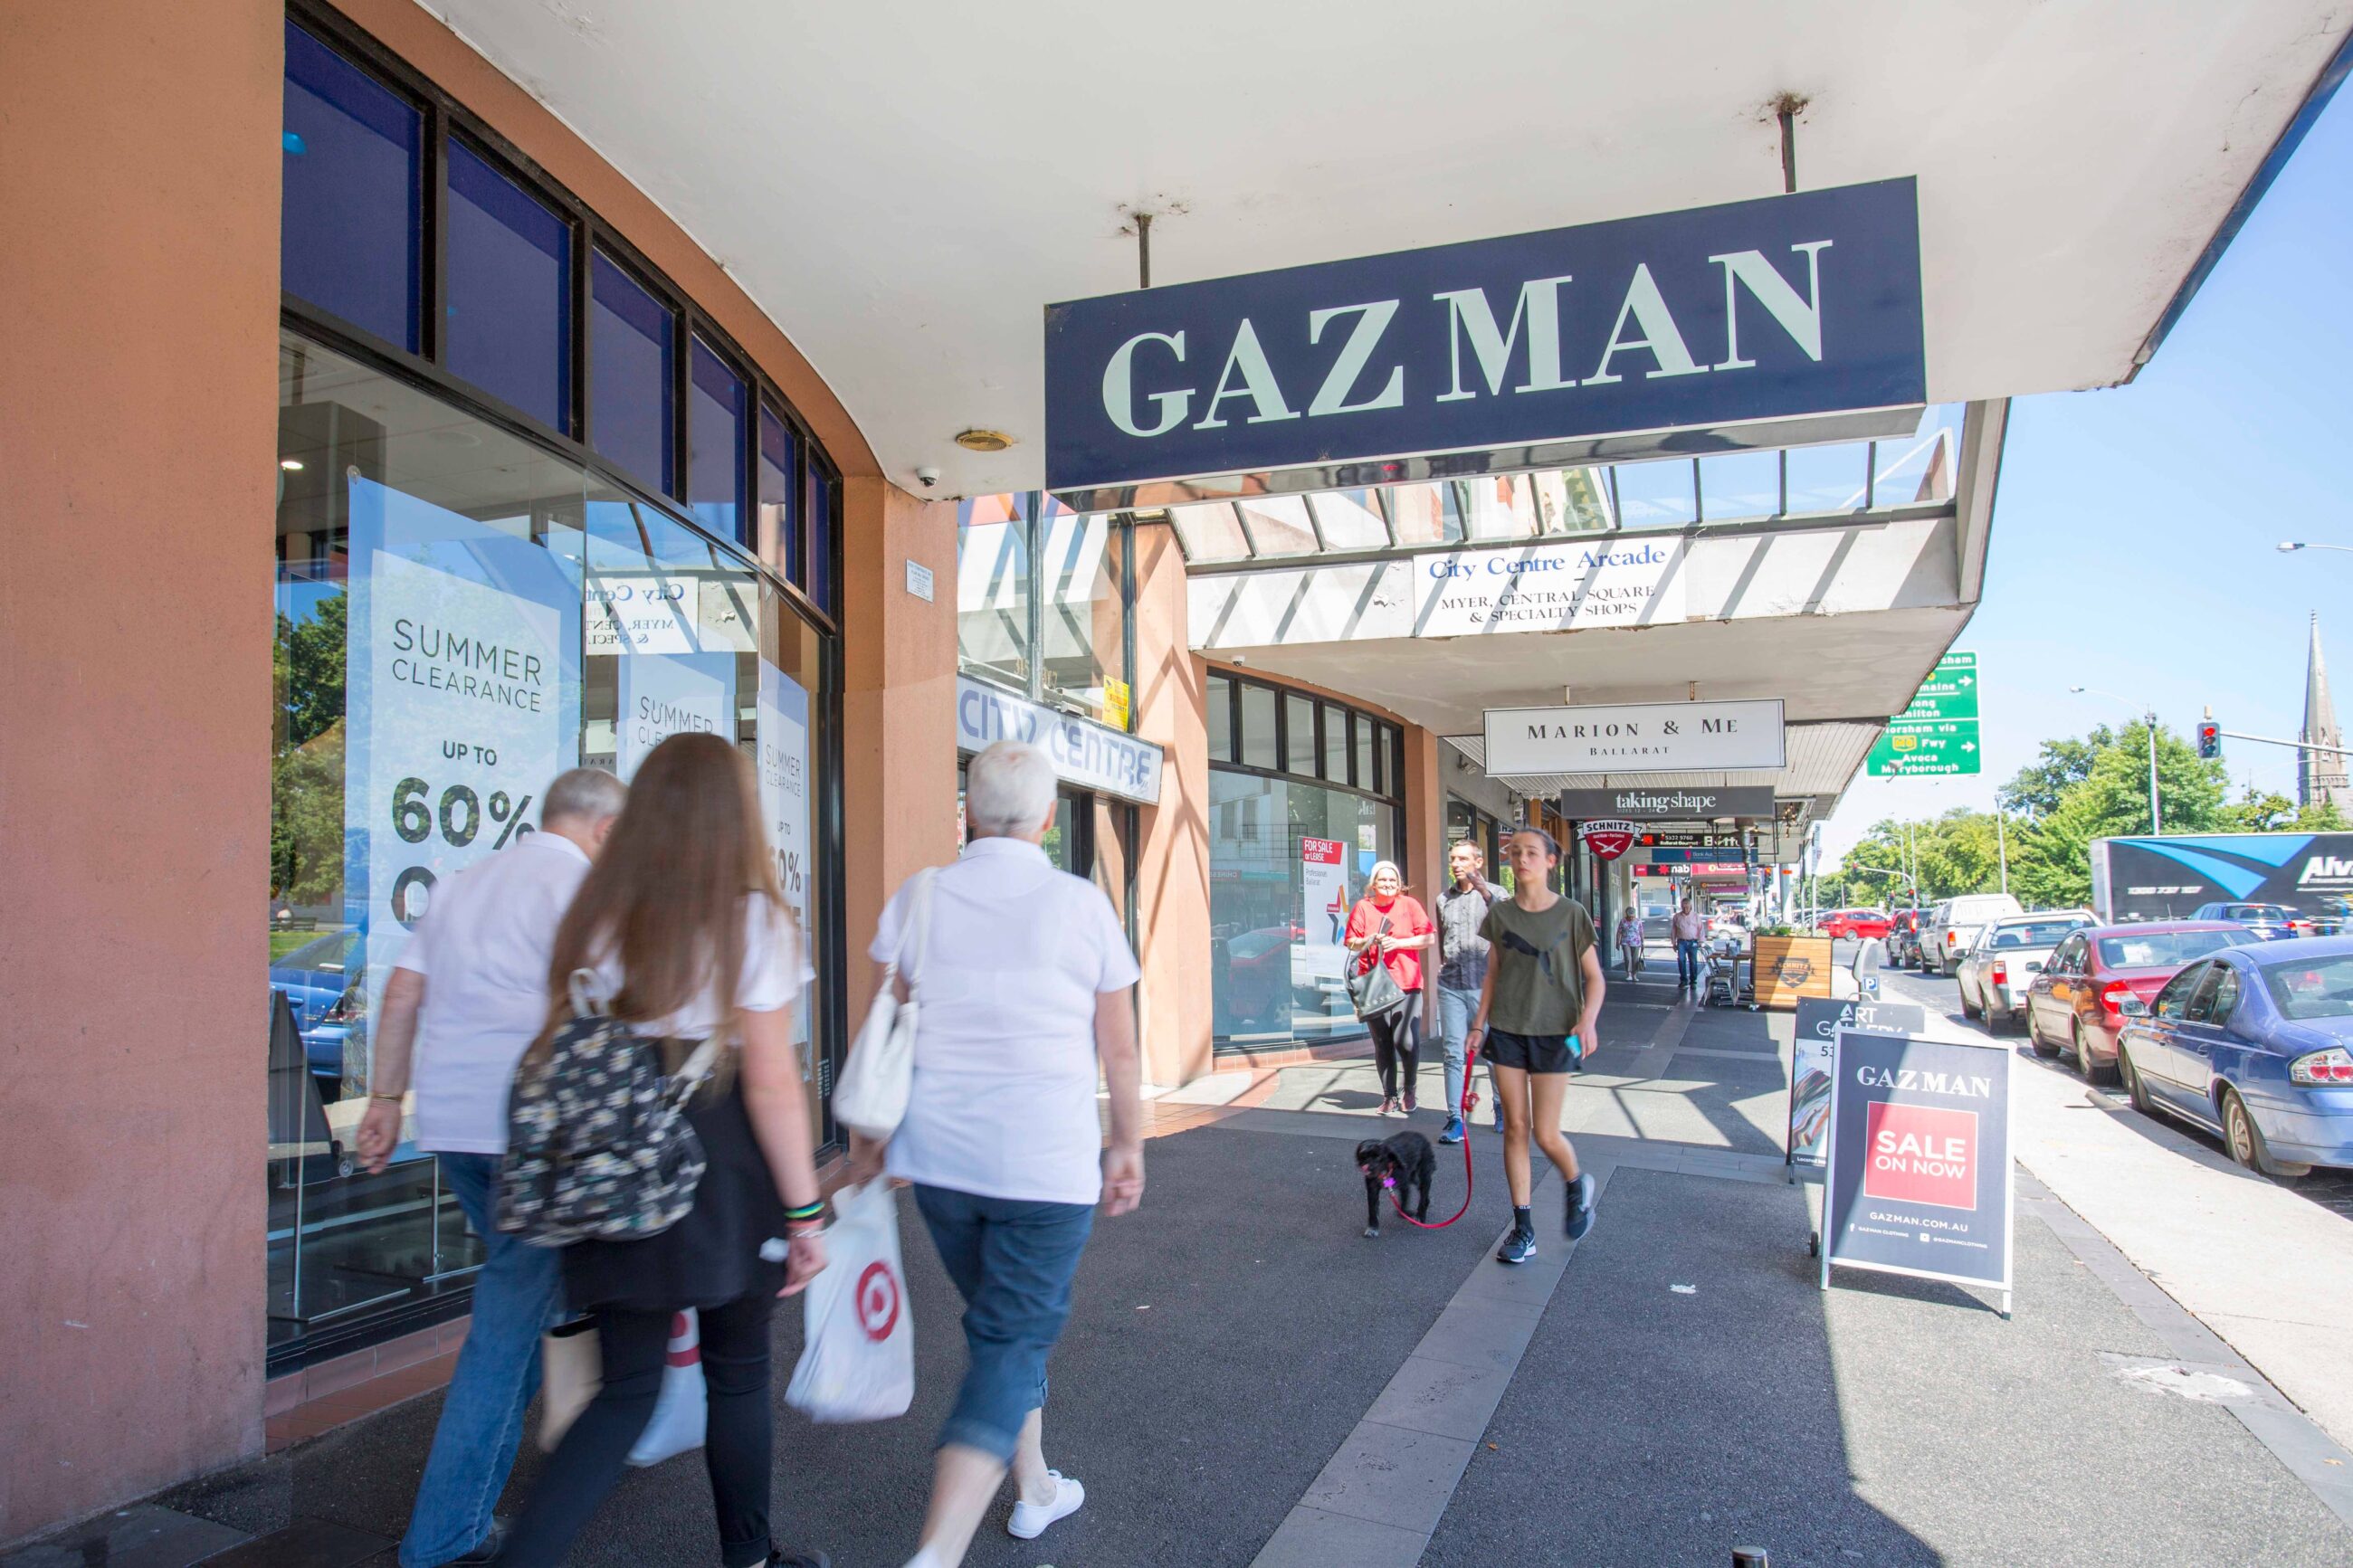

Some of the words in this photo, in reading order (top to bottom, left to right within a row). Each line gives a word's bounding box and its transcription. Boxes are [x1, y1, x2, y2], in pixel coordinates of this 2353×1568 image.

[1102, 239, 1833, 438] GAZMAN
[1429, 560, 1476, 581] City
[1487, 556, 1565, 575] Centre
[1577, 544, 1666, 568] Arcade
[1441, 597, 1493, 610] MYER,
[1499, 591, 1581, 606] CENTRAL
[1587, 585, 1656, 601] SQUARE
[1469, 612, 1484, 622] &
[1491, 606, 1579, 622] SPECIALTY
[1586, 602, 1637, 615] SHOPS
[393, 618, 541, 686] SUMMER
[392, 659, 541, 713] CLEARANCE
[1528, 723, 1639, 739] MARION
[1663, 720, 1680, 735] &
[1701, 718, 1739, 734] ME
[1939, 724, 1957, 732] via
[443, 740, 468, 761] UP
[474, 746, 498, 766] TO
[1051, 720, 1151, 784] CENTRE
[1590, 746, 1670, 756] BALLARAT
[1921, 738, 1947, 748] Fwy
[766, 744, 801, 779] SUMMER
[1902, 754, 1938, 763] Avoca
[766, 770, 801, 797] CLEARANCE
[1615, 792, 1671, 813] taking
[1671, 791, 1717, 813] shape
[392, 776, 536, 851] 60%
[776, 821, 785, 832] UP
[785, 823, 791, 835] TO
[1586, 822, 1630, 832] SCHNITZ
[1304, 840, 1317, 851] FOR
[1318, 841, 1333, 853] SALE
[1310, 852, 1324, 861] LEASE
[1671, 864, 1690, 873] nab
[1840, 1003, 1878, 1023] ART
[1857, 1066, 1992, 1098] GAZMAN
[1877, 1130, 1966, 1162] SALE
[1875, 1155, 1906, 1173] ON
[1913, 1159, 1966, 1179] NOW
[1858, 1226, 1881, 1234] GAZMAN
[1882, 1230, 1910, 1238] CLOTHING
[1870, 1212, 1968, 1232] GAZMAN.COM.AU
